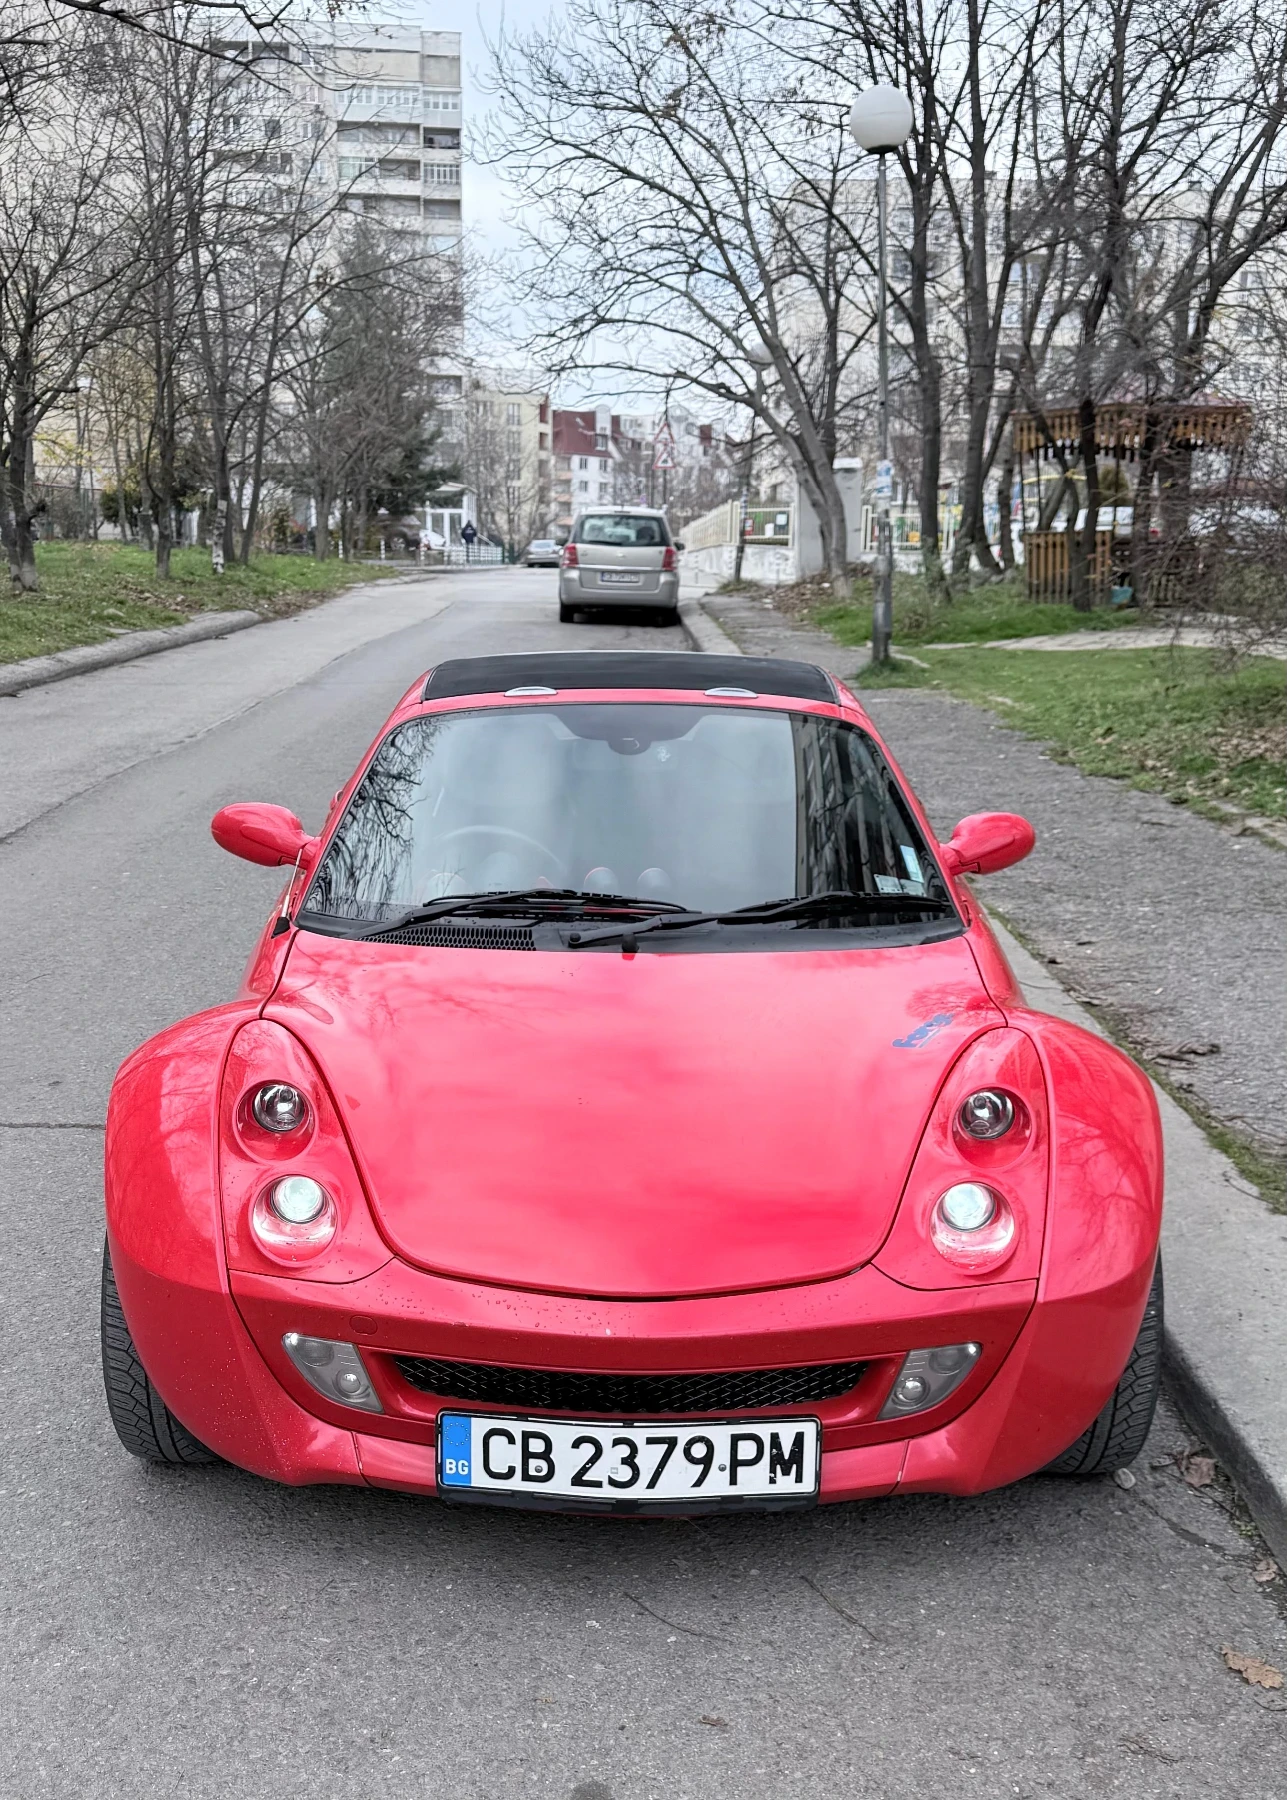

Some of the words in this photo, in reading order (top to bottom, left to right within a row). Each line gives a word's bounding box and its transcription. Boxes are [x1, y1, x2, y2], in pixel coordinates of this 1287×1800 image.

[445, 1459, 469, 1475] BG
[482, 1427, 556, 1484] CB
[570, 1435, 715, 1490] 2379
[729, 1431, 805, 1486] PM
